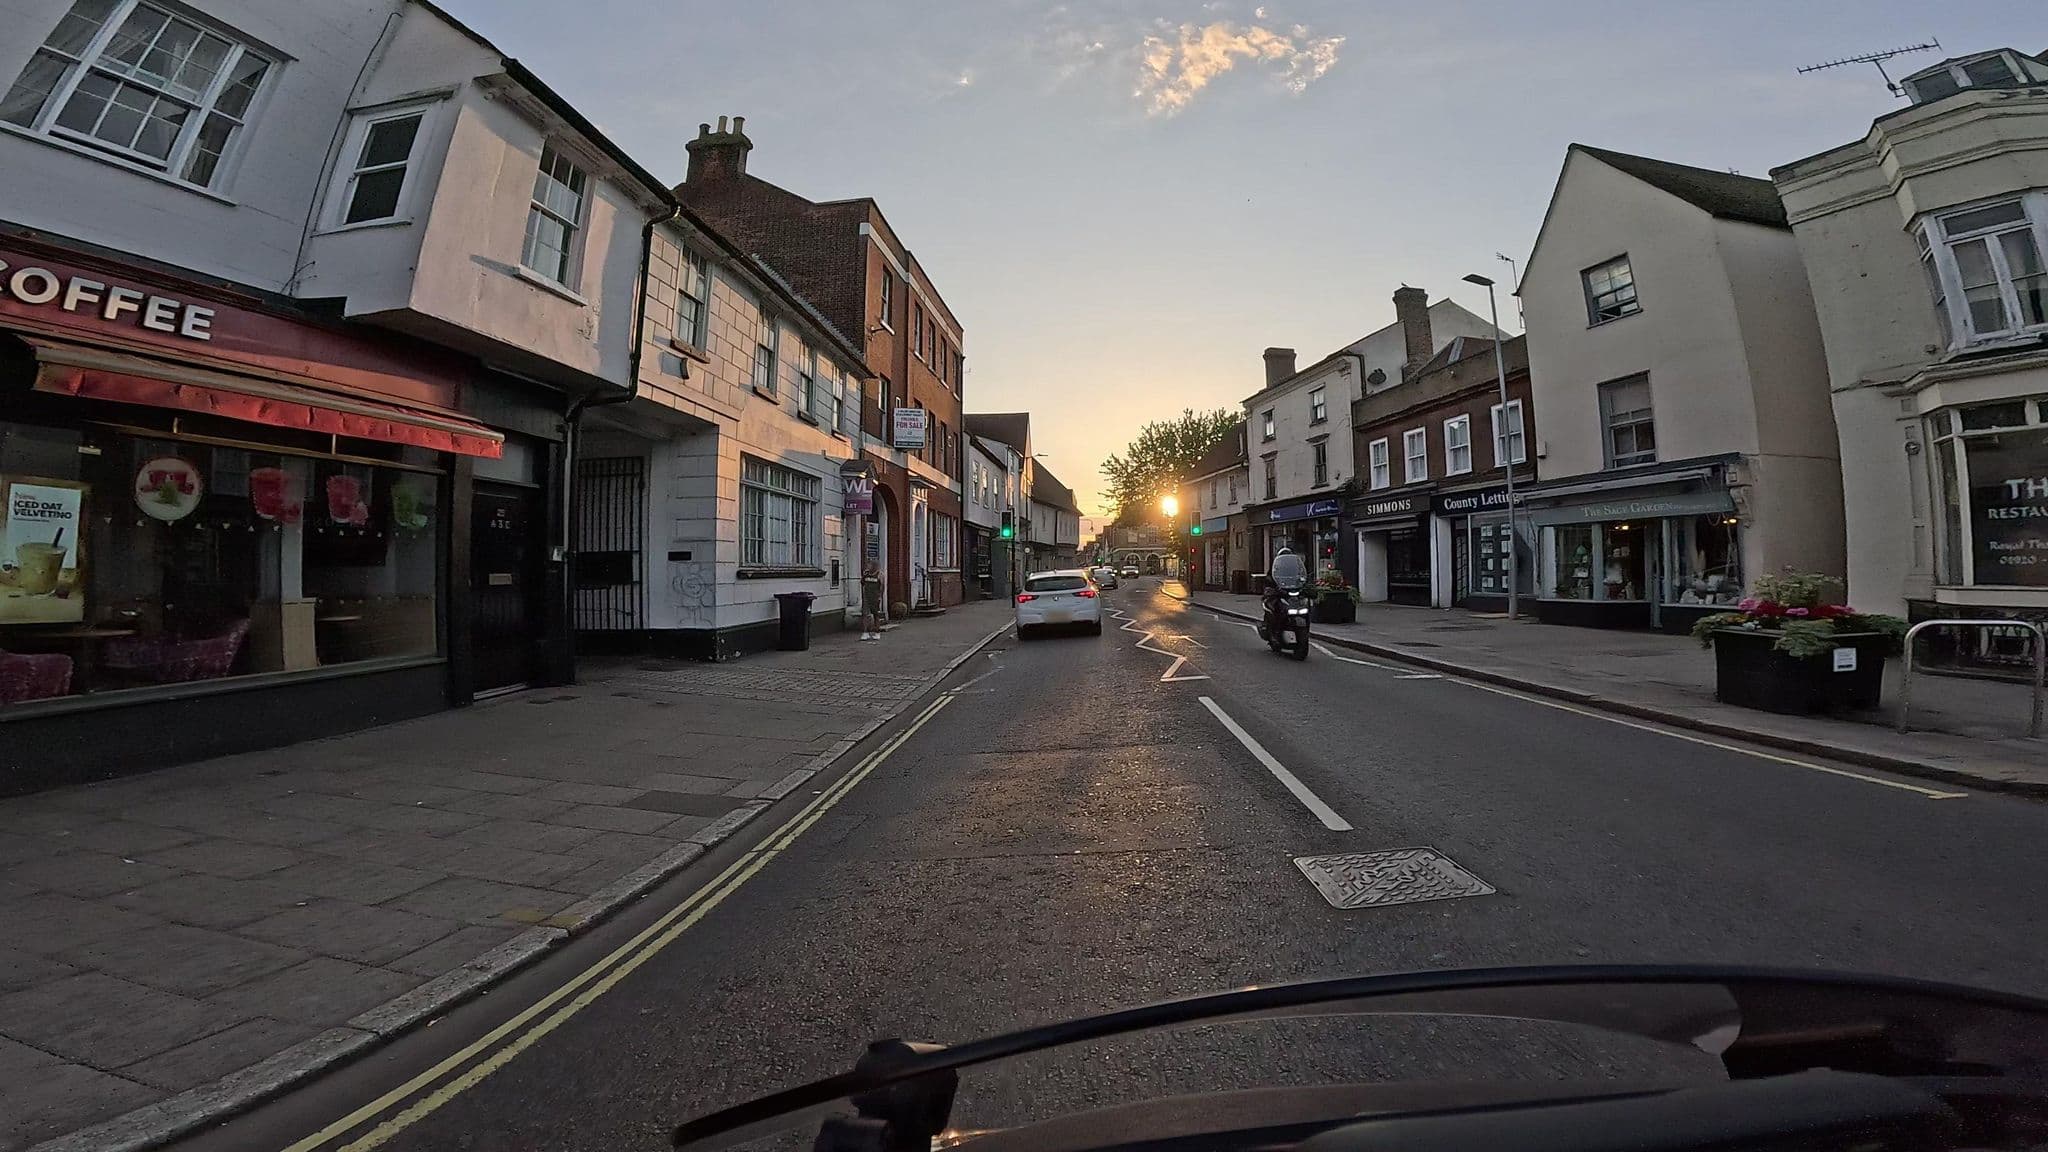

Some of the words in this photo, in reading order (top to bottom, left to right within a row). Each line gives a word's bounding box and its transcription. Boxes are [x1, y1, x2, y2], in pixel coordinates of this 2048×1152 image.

[0, 259, 216, 341] OFFEE
[896, 421, 908, 429] FOR
[909, 421, 923, 429] SALE
[14, 500, 39, 509] ICED
[41, 502, 63, 510] OAT
[1367, 499, 1411, 515] SIMMONS
[1444, 498, 1478, 510] County
[1630, 502, 1673, 513] GARDEN
[13, 508, 73, 519] VELVETINO
